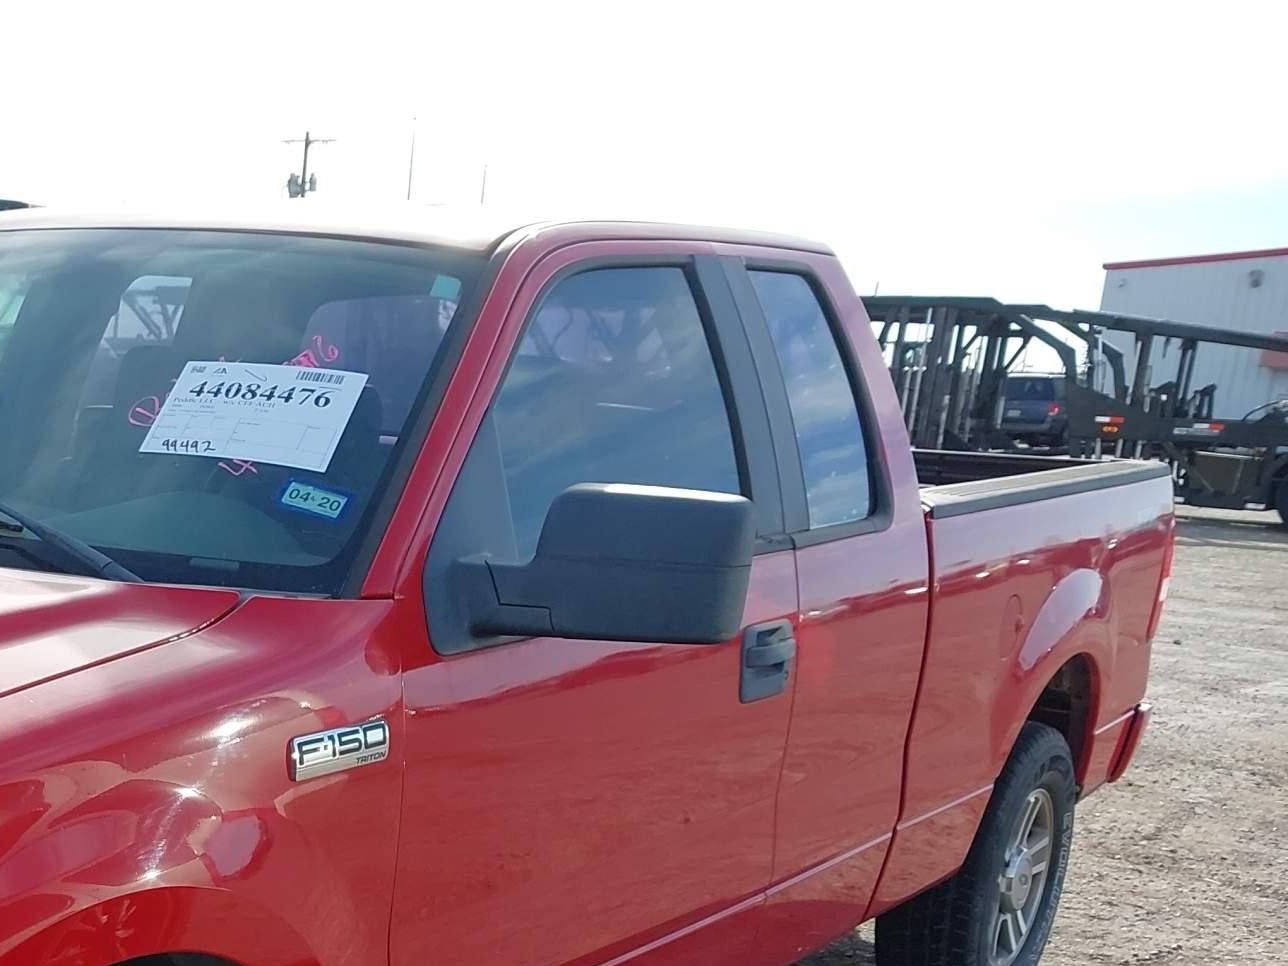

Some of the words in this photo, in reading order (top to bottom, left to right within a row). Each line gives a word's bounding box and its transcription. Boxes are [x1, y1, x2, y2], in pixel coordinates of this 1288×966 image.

[189, 381, 332, 408] 44084476
[162, 439, 216, 453] 99492
[355, 750, 387, 765] TRITON
